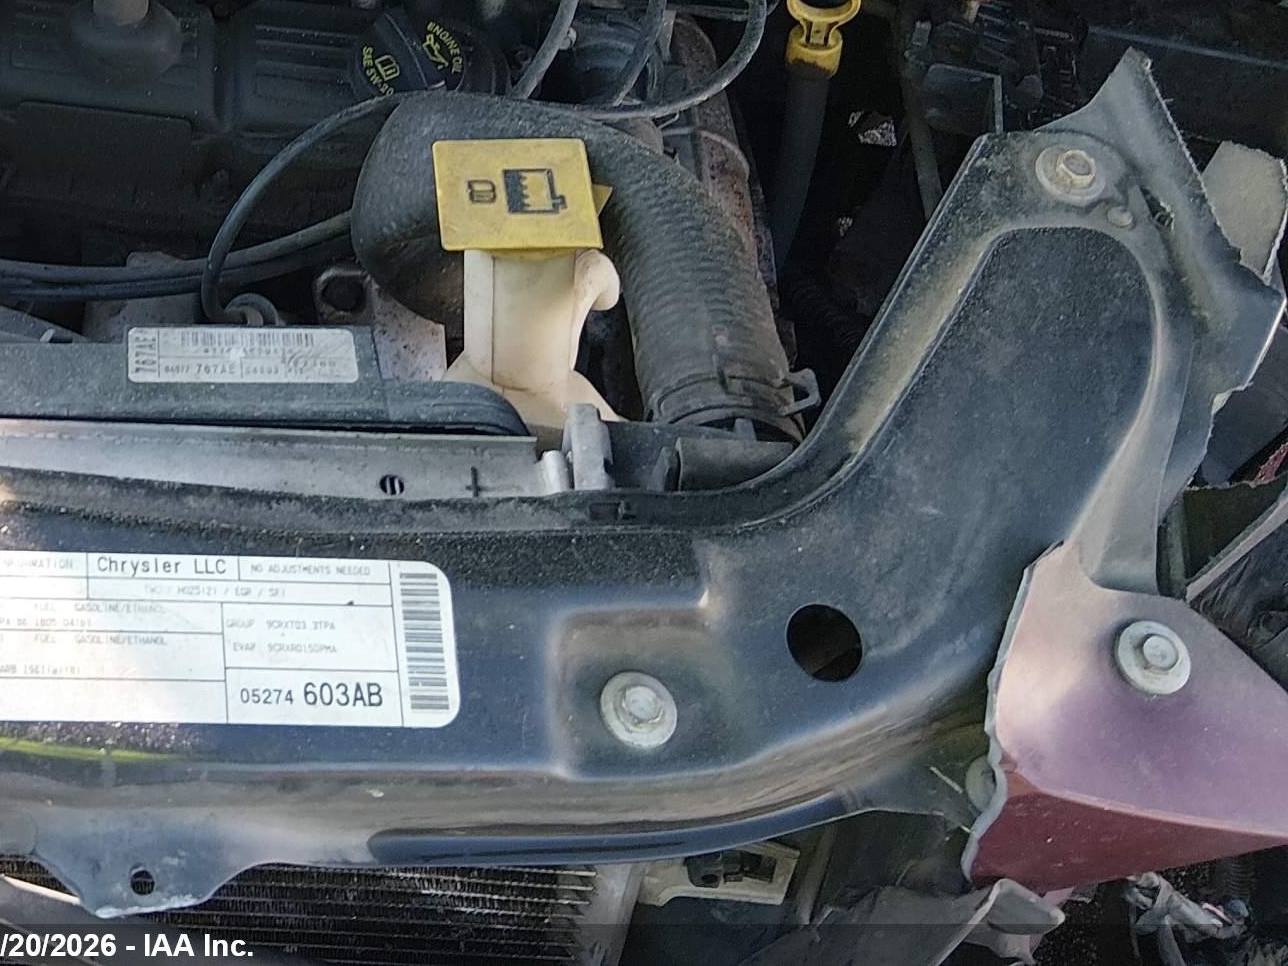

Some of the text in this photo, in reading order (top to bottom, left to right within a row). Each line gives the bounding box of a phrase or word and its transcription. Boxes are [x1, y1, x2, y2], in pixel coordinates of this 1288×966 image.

[426, 21, 461, 56] ENGINE
[362, 46, 373, 68] SAE
[97, 556, 226, 577] Chrysler LLC
[251, 564, 370, 576] NO ADJUSTMENTS NEEDED
[74, 634, 168, 646] GASOLINE/ETHANOL
[240, 682, 383, 707] 05274 603AB
